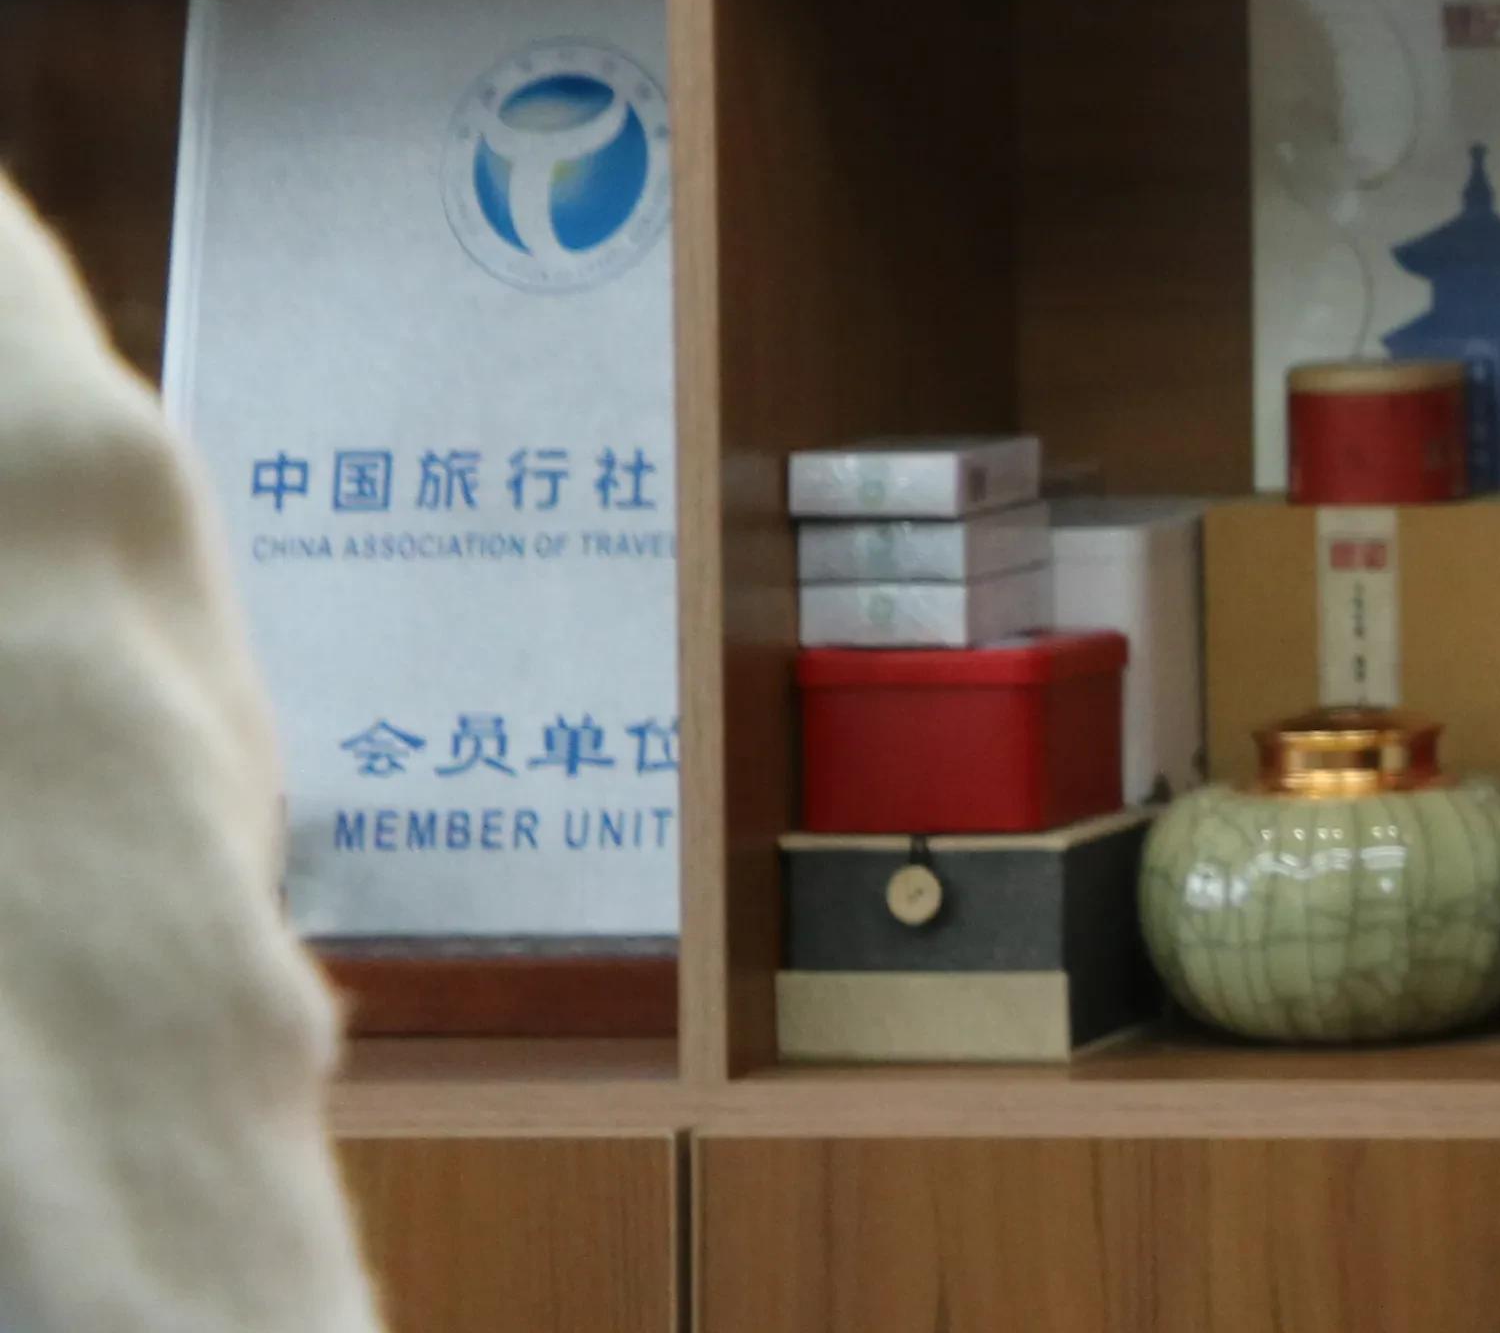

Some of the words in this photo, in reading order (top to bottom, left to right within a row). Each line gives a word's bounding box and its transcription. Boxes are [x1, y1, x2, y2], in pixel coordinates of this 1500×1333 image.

[251, 446, 658, 514] 中国旅行社
[252, 533, 333, 564] CHINA
[341, 532, 525, 562] ASSOCIATION
[534, 533, 568, 559] OF
[339, 712, 681, 777] 会员单位
[333, 808, 541, 853] MEMBER
[564, 806, 673, 851] UNIT
